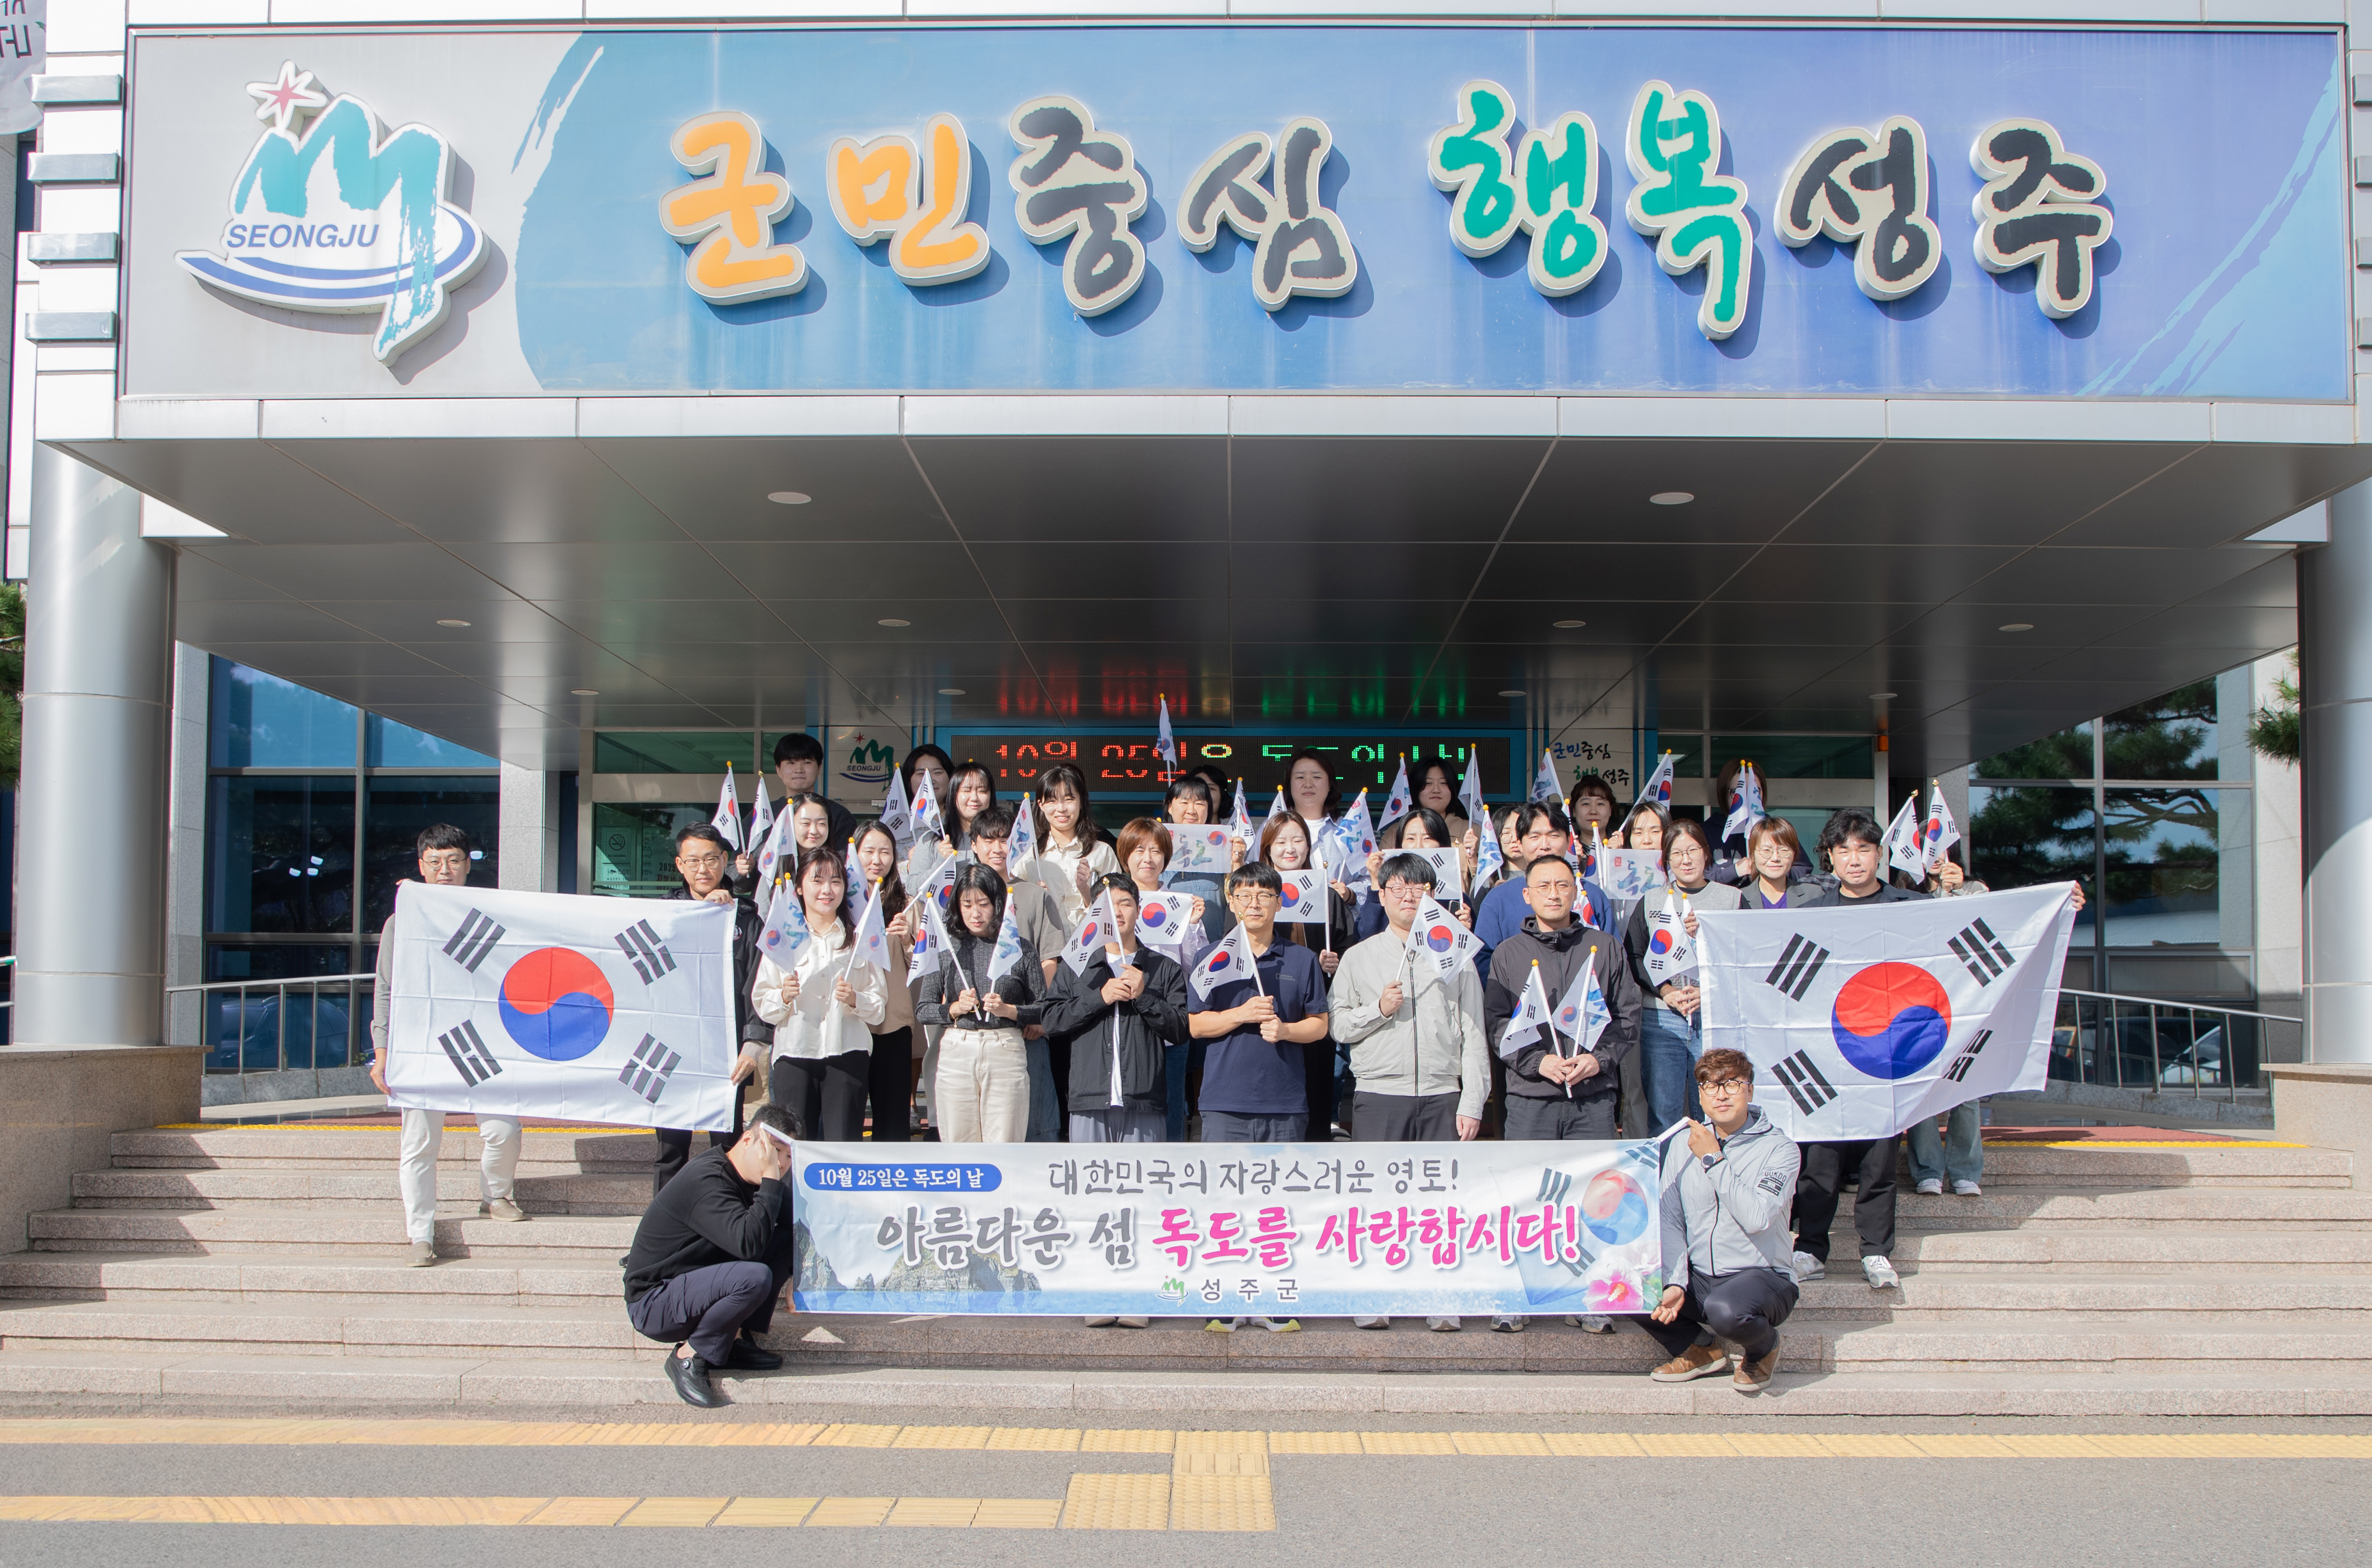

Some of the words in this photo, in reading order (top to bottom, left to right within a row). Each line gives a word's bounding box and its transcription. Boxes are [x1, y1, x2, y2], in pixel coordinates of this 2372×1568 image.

[227, 224, 379, 248] SEONGJU
[819, 1167, 853, 1187] 10월
[858, 1167, 909, 1187] 25일은
[912, 1167, 961, 1189] 독도의
[966, 1167, 984, 1188] 날
[1048, 1158, 1207, 1195] 대한민국의
[1219, 1158, 1375, 1195] 자랑스러운
[1387, 1158, 1458, 1194] 영토!
[877, 1205, 1071, 1264] 아름다운
[1088, 1207, 1133, 1264] 섬
[1152, 1206, 1297, 1268] 독도를
[1315, 1204, 1580, 1266] 사랑합시다!
